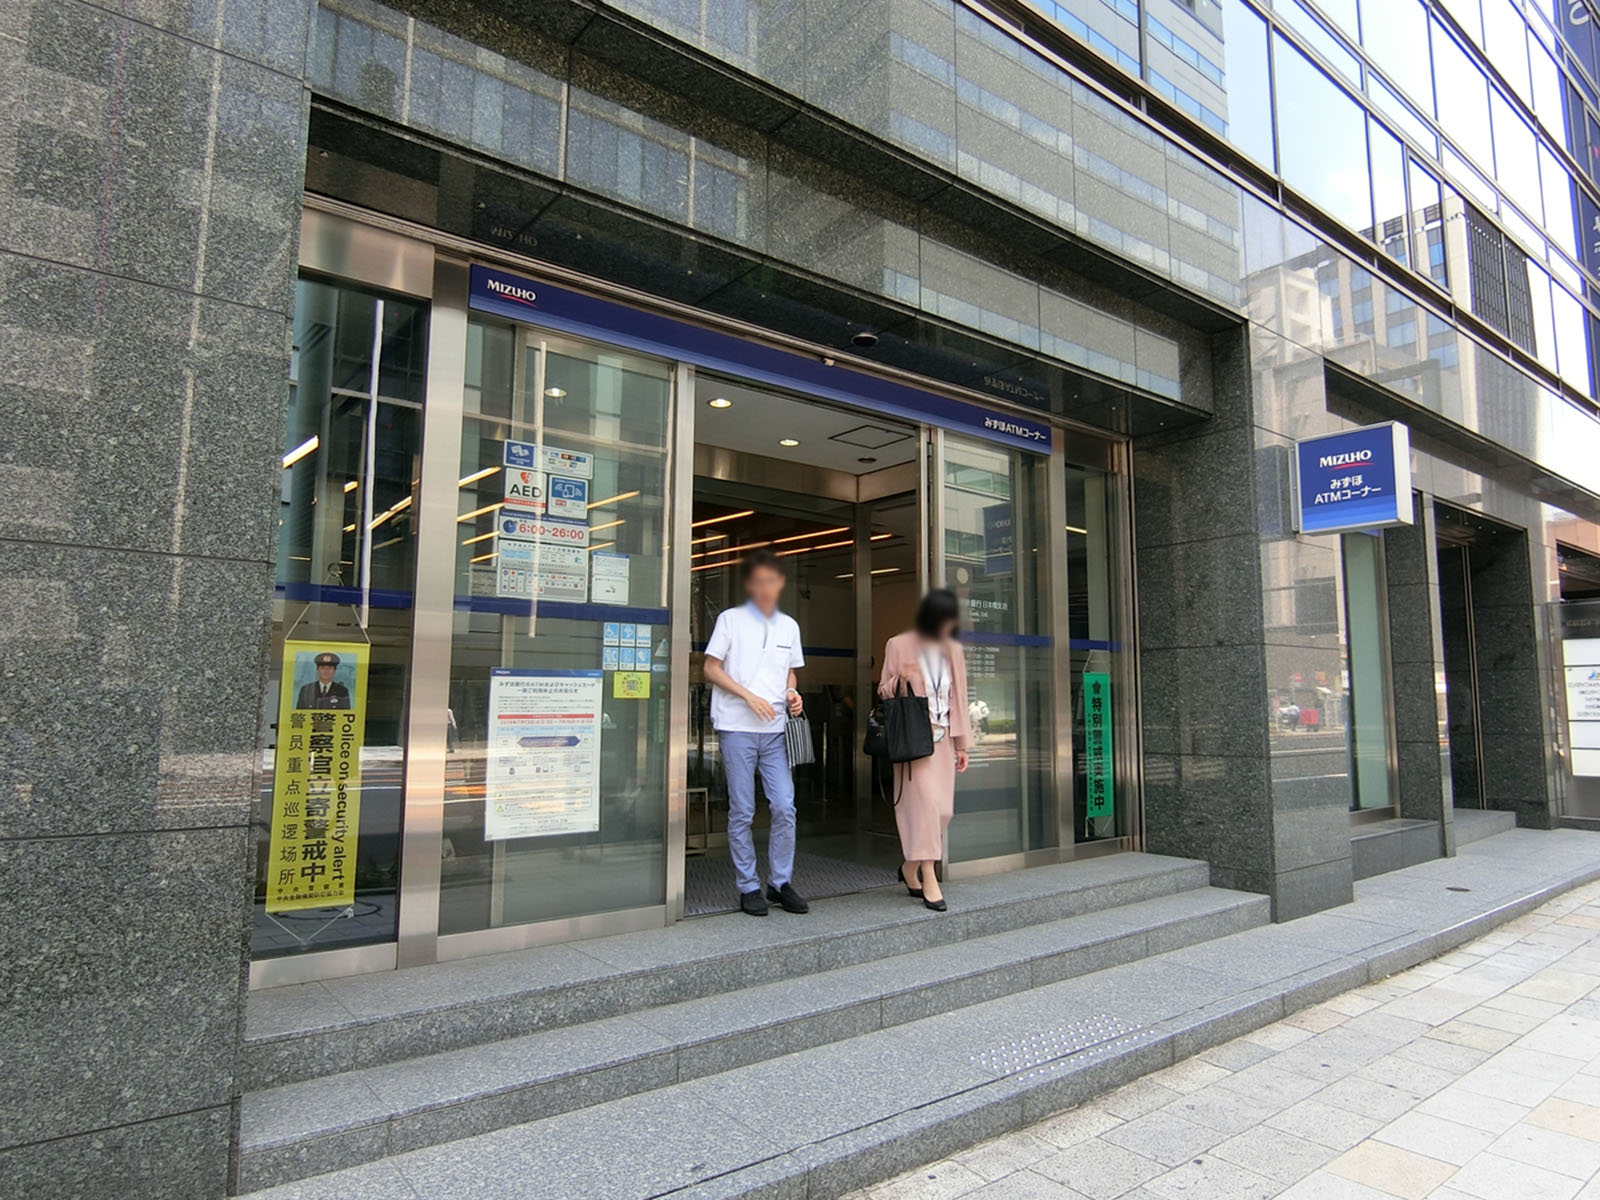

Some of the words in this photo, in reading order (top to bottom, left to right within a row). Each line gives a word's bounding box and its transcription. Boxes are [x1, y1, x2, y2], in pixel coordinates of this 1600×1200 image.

[487, 279, 536, 301] MIZUHO
[984, 417, 1047, 441] みずほATMコーナー
[1319, 449, 1372, 468] MIZUHO
[509, 483, 542, 499] AED
[1330, 474, 1363, 489] みずほ
[1314, 485, 1381, 505] ATMコーナー
[339, 713, 356, 758] Police
[338, 761, 350, 779] on
[278, 712, 307, 885] 警员重点巡逻场所
[300, 712, 337, 883] 警察官立寄警戒中
[331, 784, 348, 843] security
[331, 847, 347, 880] alert
